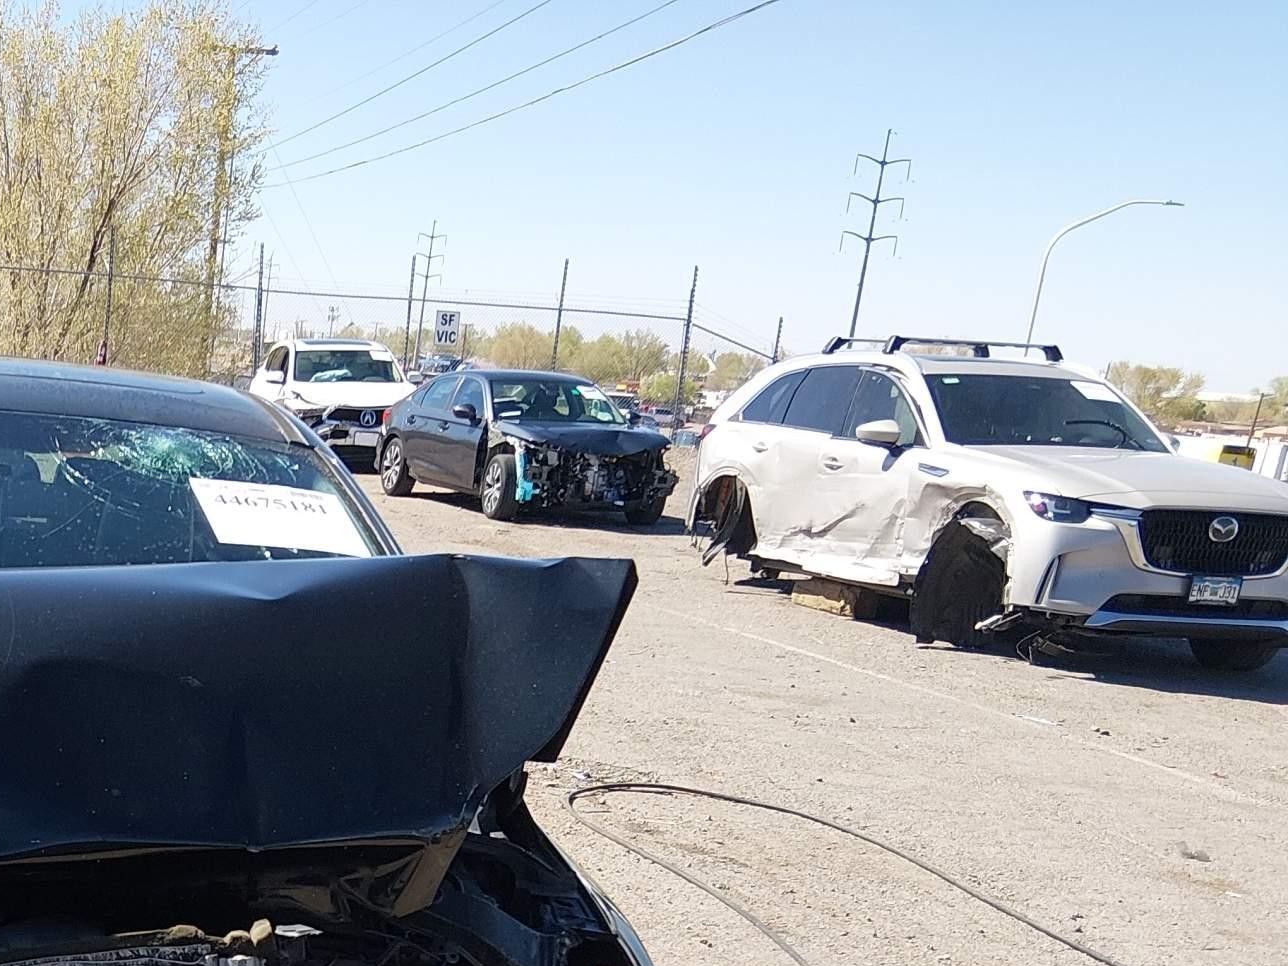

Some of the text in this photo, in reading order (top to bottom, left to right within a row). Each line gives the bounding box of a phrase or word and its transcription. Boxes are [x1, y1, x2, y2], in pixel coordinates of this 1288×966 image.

[440, 313, 456, 327] SF
[436, 330, 457, 344] VIC
[214, 493, 328, 514] 44675181
